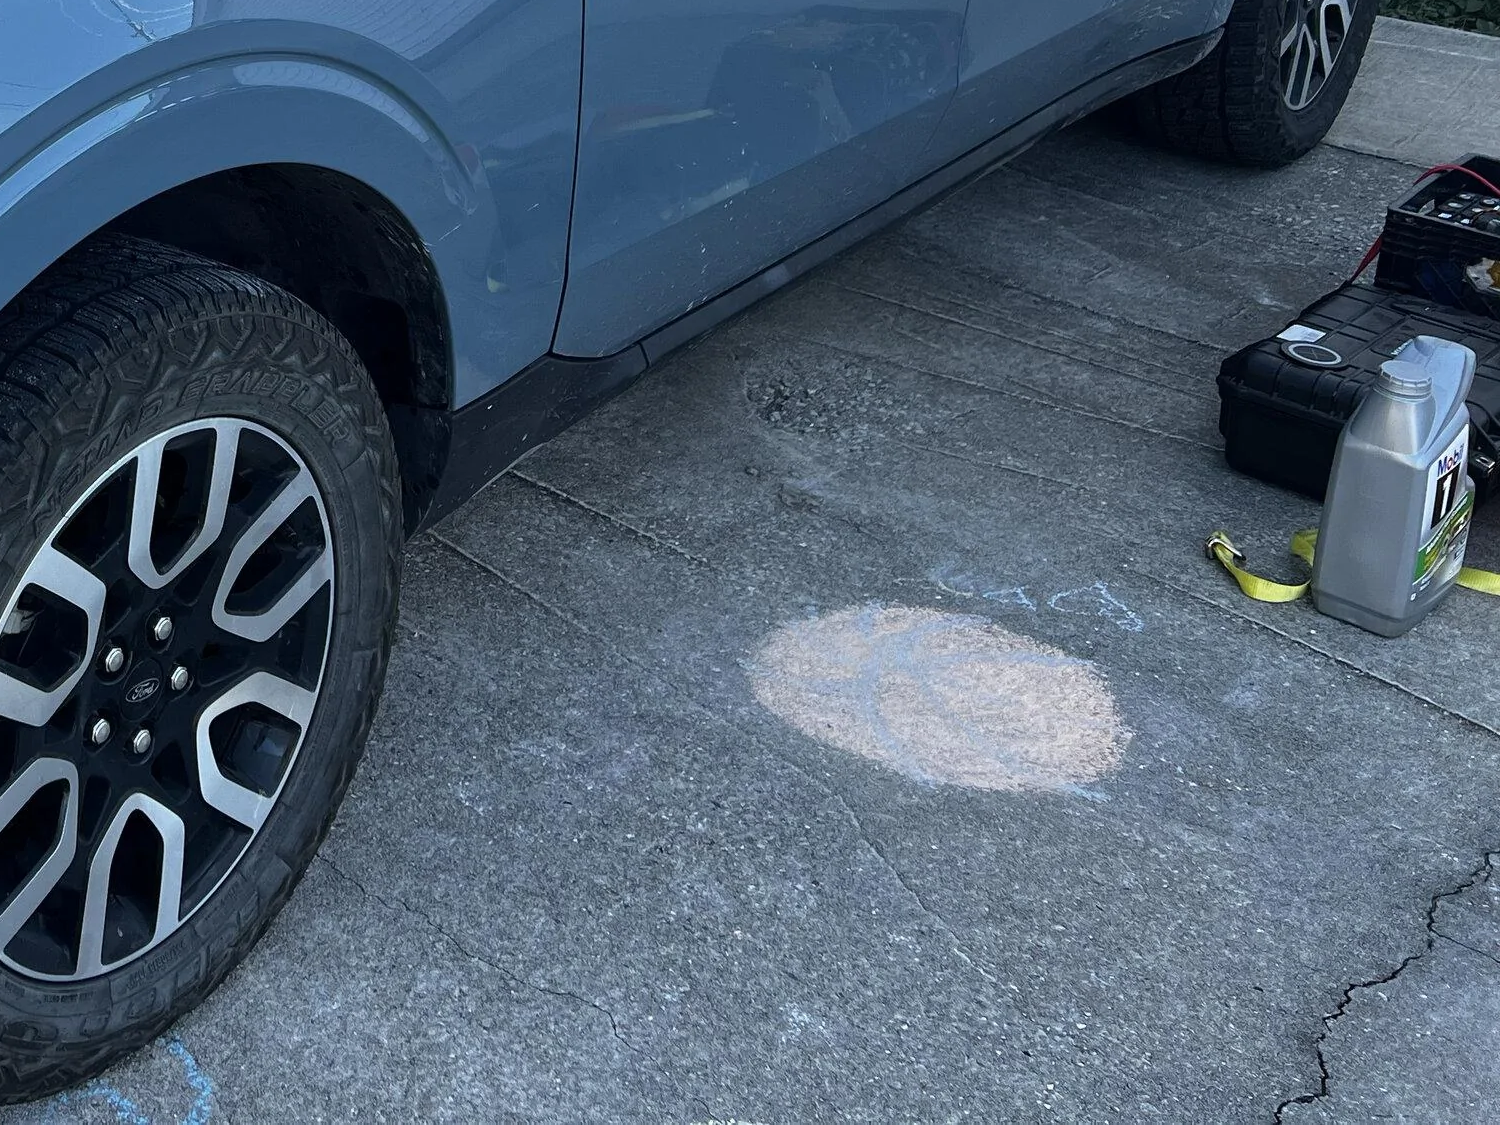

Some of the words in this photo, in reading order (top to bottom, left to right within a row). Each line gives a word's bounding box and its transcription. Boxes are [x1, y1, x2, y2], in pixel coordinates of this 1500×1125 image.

[180, 371, 352, 444] GRAPPLER
[1436, 442, 1465, 479] Mobil
[131, 681, 155, 701] Ford
